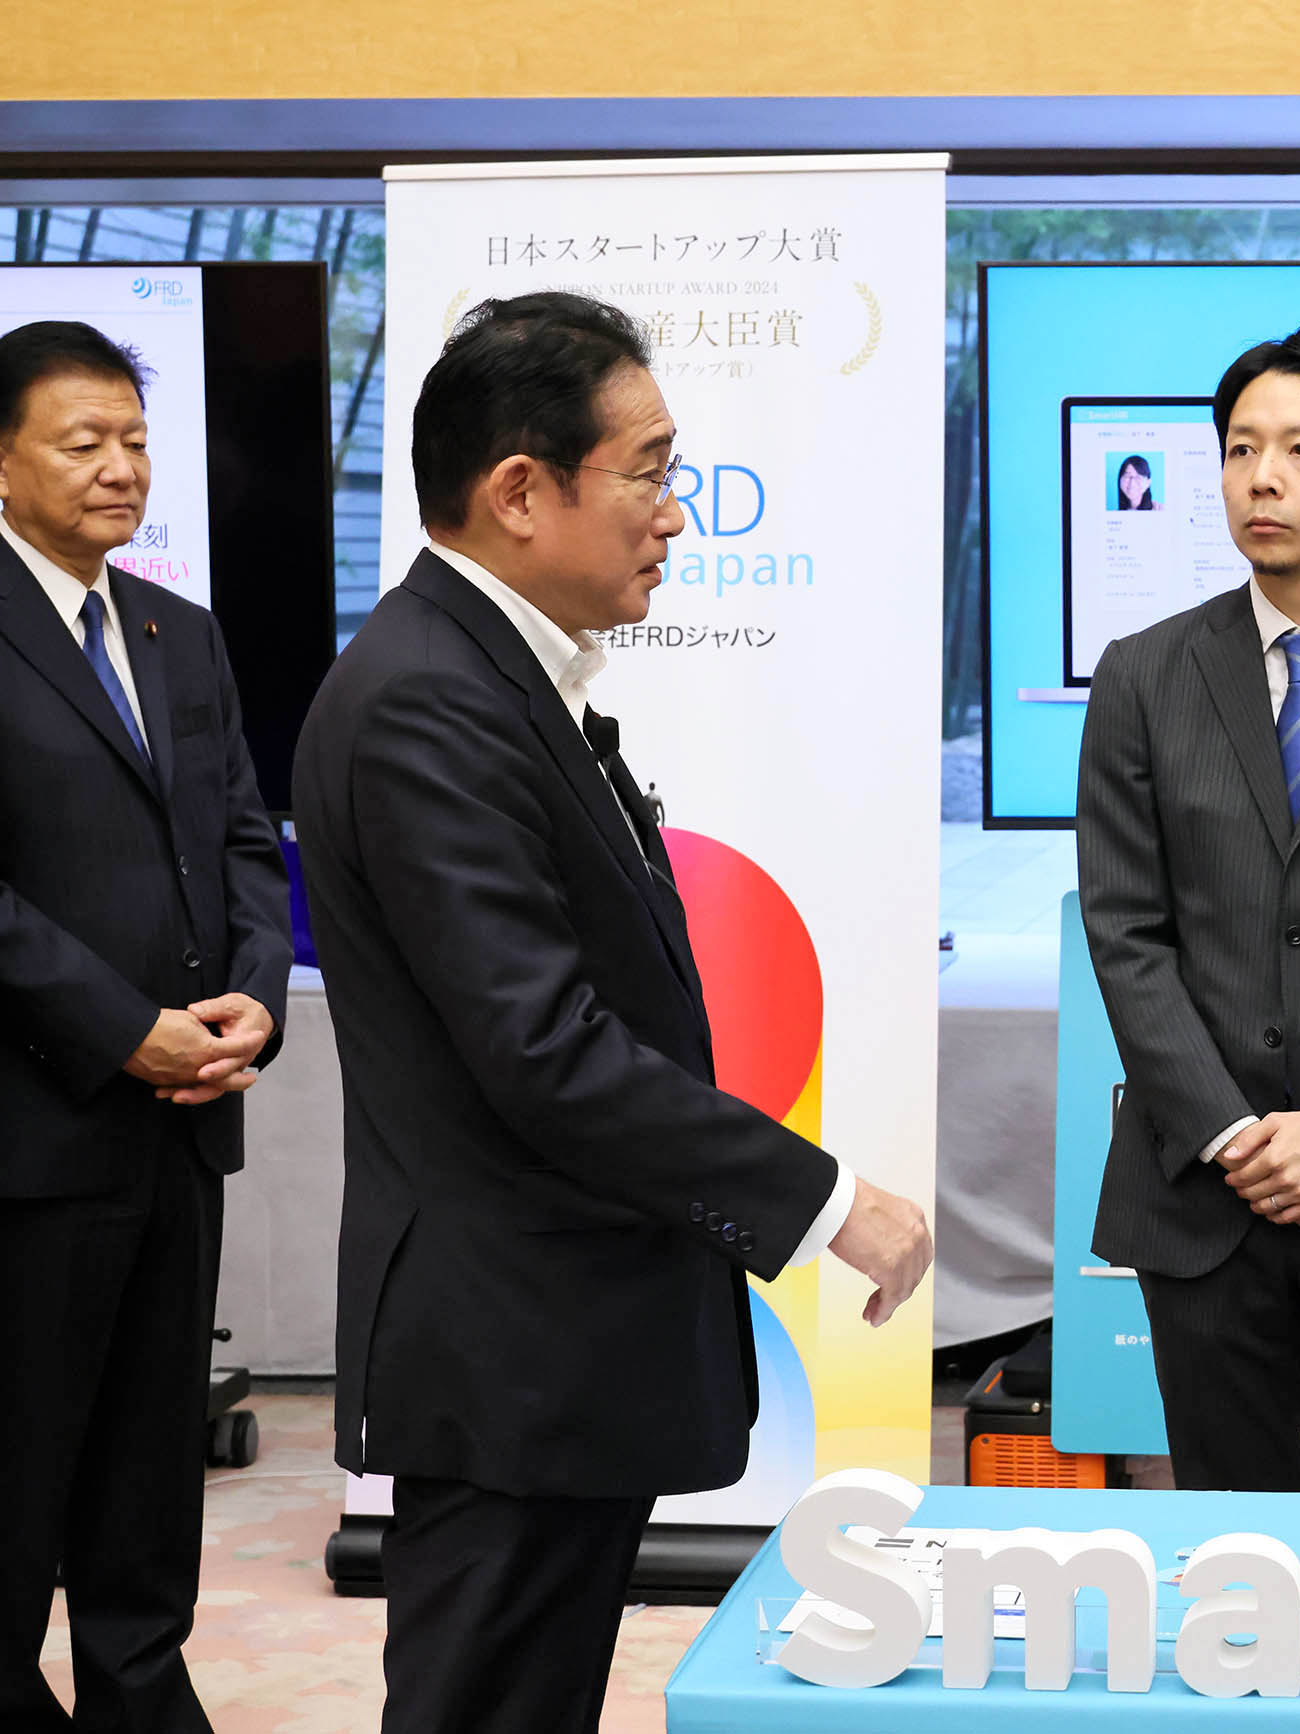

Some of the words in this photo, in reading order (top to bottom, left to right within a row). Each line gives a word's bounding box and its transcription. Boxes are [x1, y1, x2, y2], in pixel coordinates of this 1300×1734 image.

[488, 227, 843, 267] 日本スタートアップ大賞
[154, 280, 183, 296] FRD
[609, 281, 675, 296] STARTUP
[681, 281, 738, 296] AWARD
[743, 280, 779, 295] 2024
